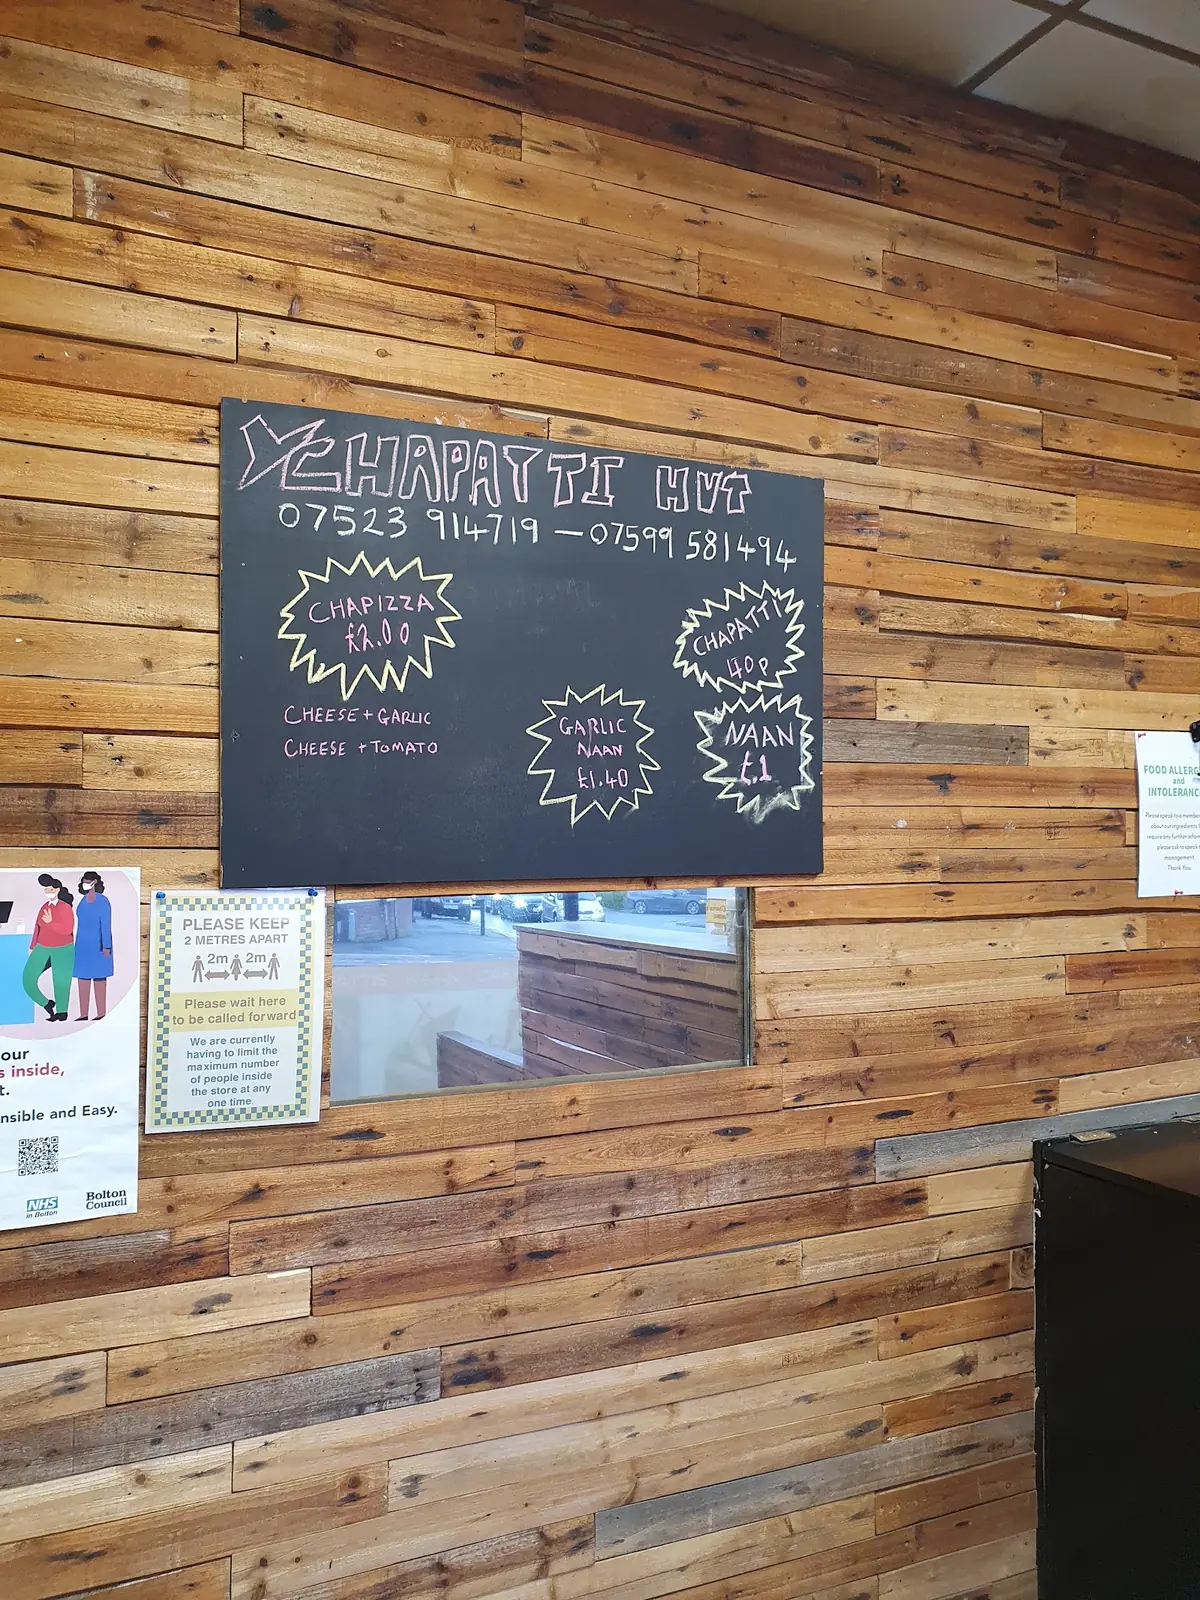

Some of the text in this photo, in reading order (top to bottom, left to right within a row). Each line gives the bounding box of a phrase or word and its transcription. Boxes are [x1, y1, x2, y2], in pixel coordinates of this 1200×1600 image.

[278, 502, 408, 538] 07523
[426, 508, 539, 545] 914719
[589, 522, 673, 559] 07599
[686, 529, 797, 573] 581494
[308, 593, 435, 623] CHAPIZZA
[692, 599, 782, 656] CHAPATTI
[345, 618, 409, 653] £2.00
[378, 708, 431, 726] GARLIC
[559, 716, 626, 736] GARLIC
[724, 721, 794, 748] NAAN
[577, 742, 623, 758] NAAN
[1144, 765, 1167, 774] FOOD
[577, 766, 629, 790] £1.40
[183, 917, 290, 930] PLEASE KEEP
[184, 933, 289, 945] 2 METRES APART
[207, 952, 267, 964] 2m 2m
[184, 996, 286, 1009] Please wait here
[172, 1010, 296, 1025] to be called forward
[190, 1034, 275, 1046] We are currently
[1, 1050, 29, 1061] our
[187, 1047, 278, 1060] having to limit the
[11, 1062, 65, 1077] inside,
[187, 1059, 280, 1071] maximum number
[190, 1071, 272, 1085] of people inside
[191, 1085, 271, 1096] the store at any
[208, 1097, 254, 1107] one time.
[50, 1106, 76, 1119] and
[82, 1105, 118, 1118] Easy.
[86, 1189, 127, 1201] Bolton
[27, 1196, 58, 1212] NHS
[86, 1197, 128, 1210] Council
[35, 1210, 58, 1218] Bolton
